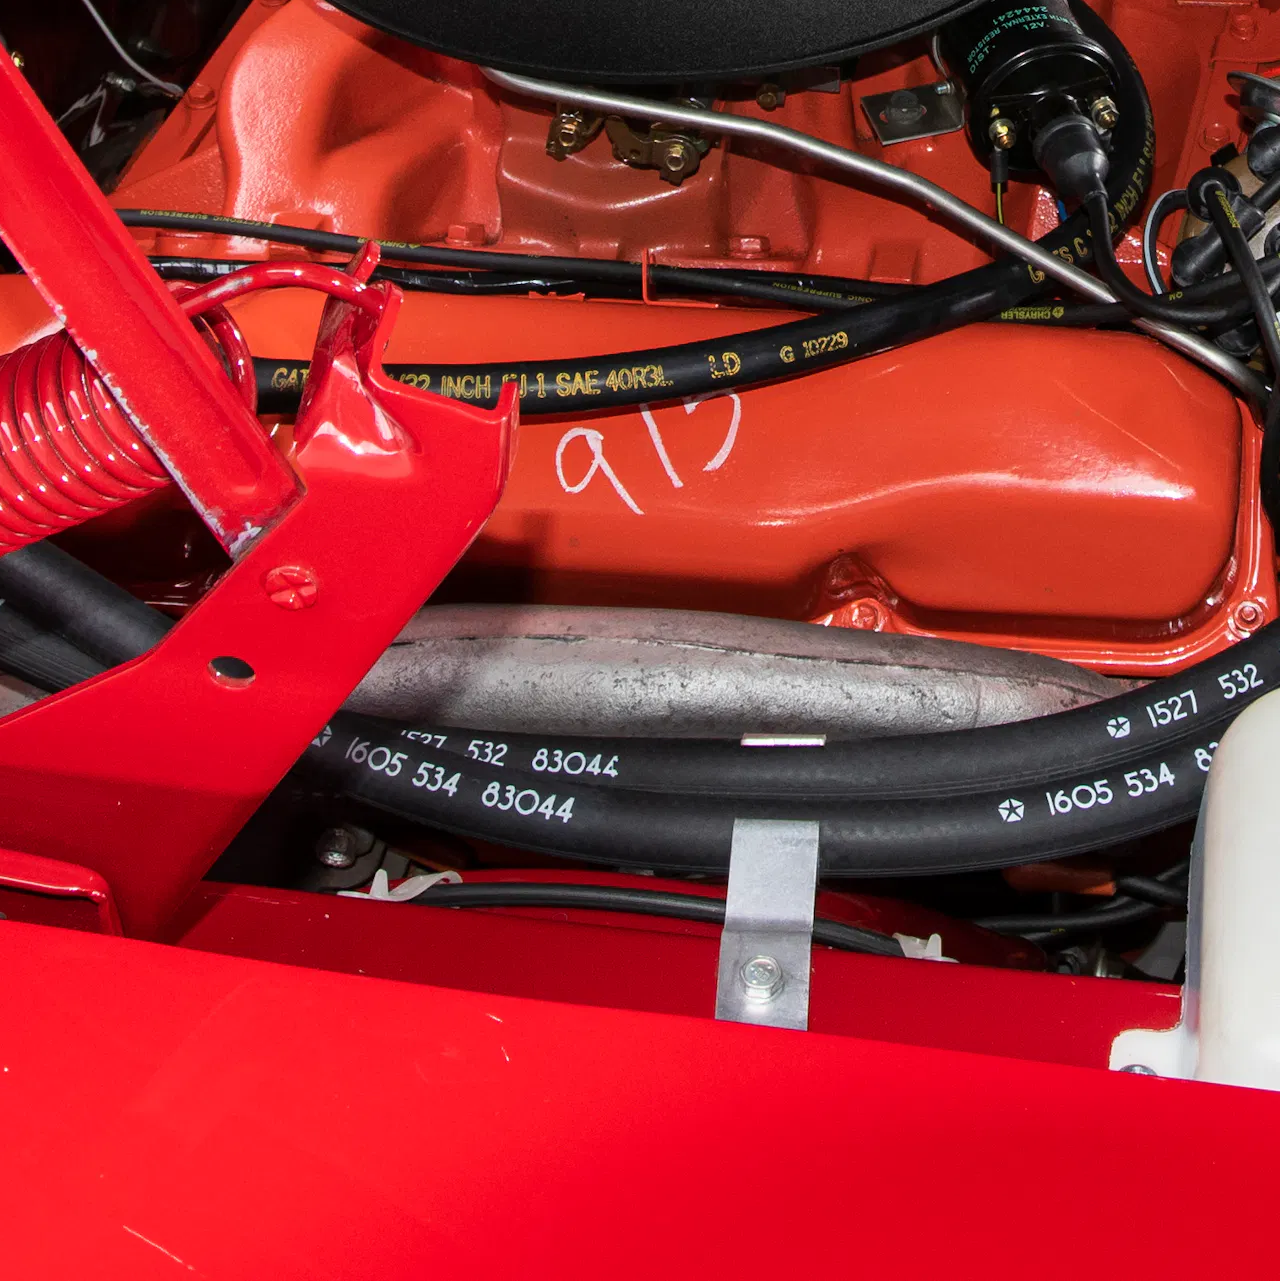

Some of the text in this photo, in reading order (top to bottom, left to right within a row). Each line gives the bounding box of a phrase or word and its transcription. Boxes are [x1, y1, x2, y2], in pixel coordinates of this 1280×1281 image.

[992, 6, 1049, 26] 2444241
[1001, 13, 1048, 30] EXTERNAL
[966, 27, 1001, 63] RESISTOR
[771, 281, 843, 300] SUPPRESSION
[1000, 311, 1052, 320] CHRYSLER
[441, 374, 491, 399] INCH
[556, 370, 602, 397] SAE
[779, 345, 796, 363] G
[1146, 688, 1199, 729] 1527
[1217, 663, 1265, 701] 532
[463, 739, 508, 767] 532
[531, 748, 619, 778] 83044
[344, 736, 576, 825] 1605 534 83044
[1045, 762, 1177, 816] 1605 534
